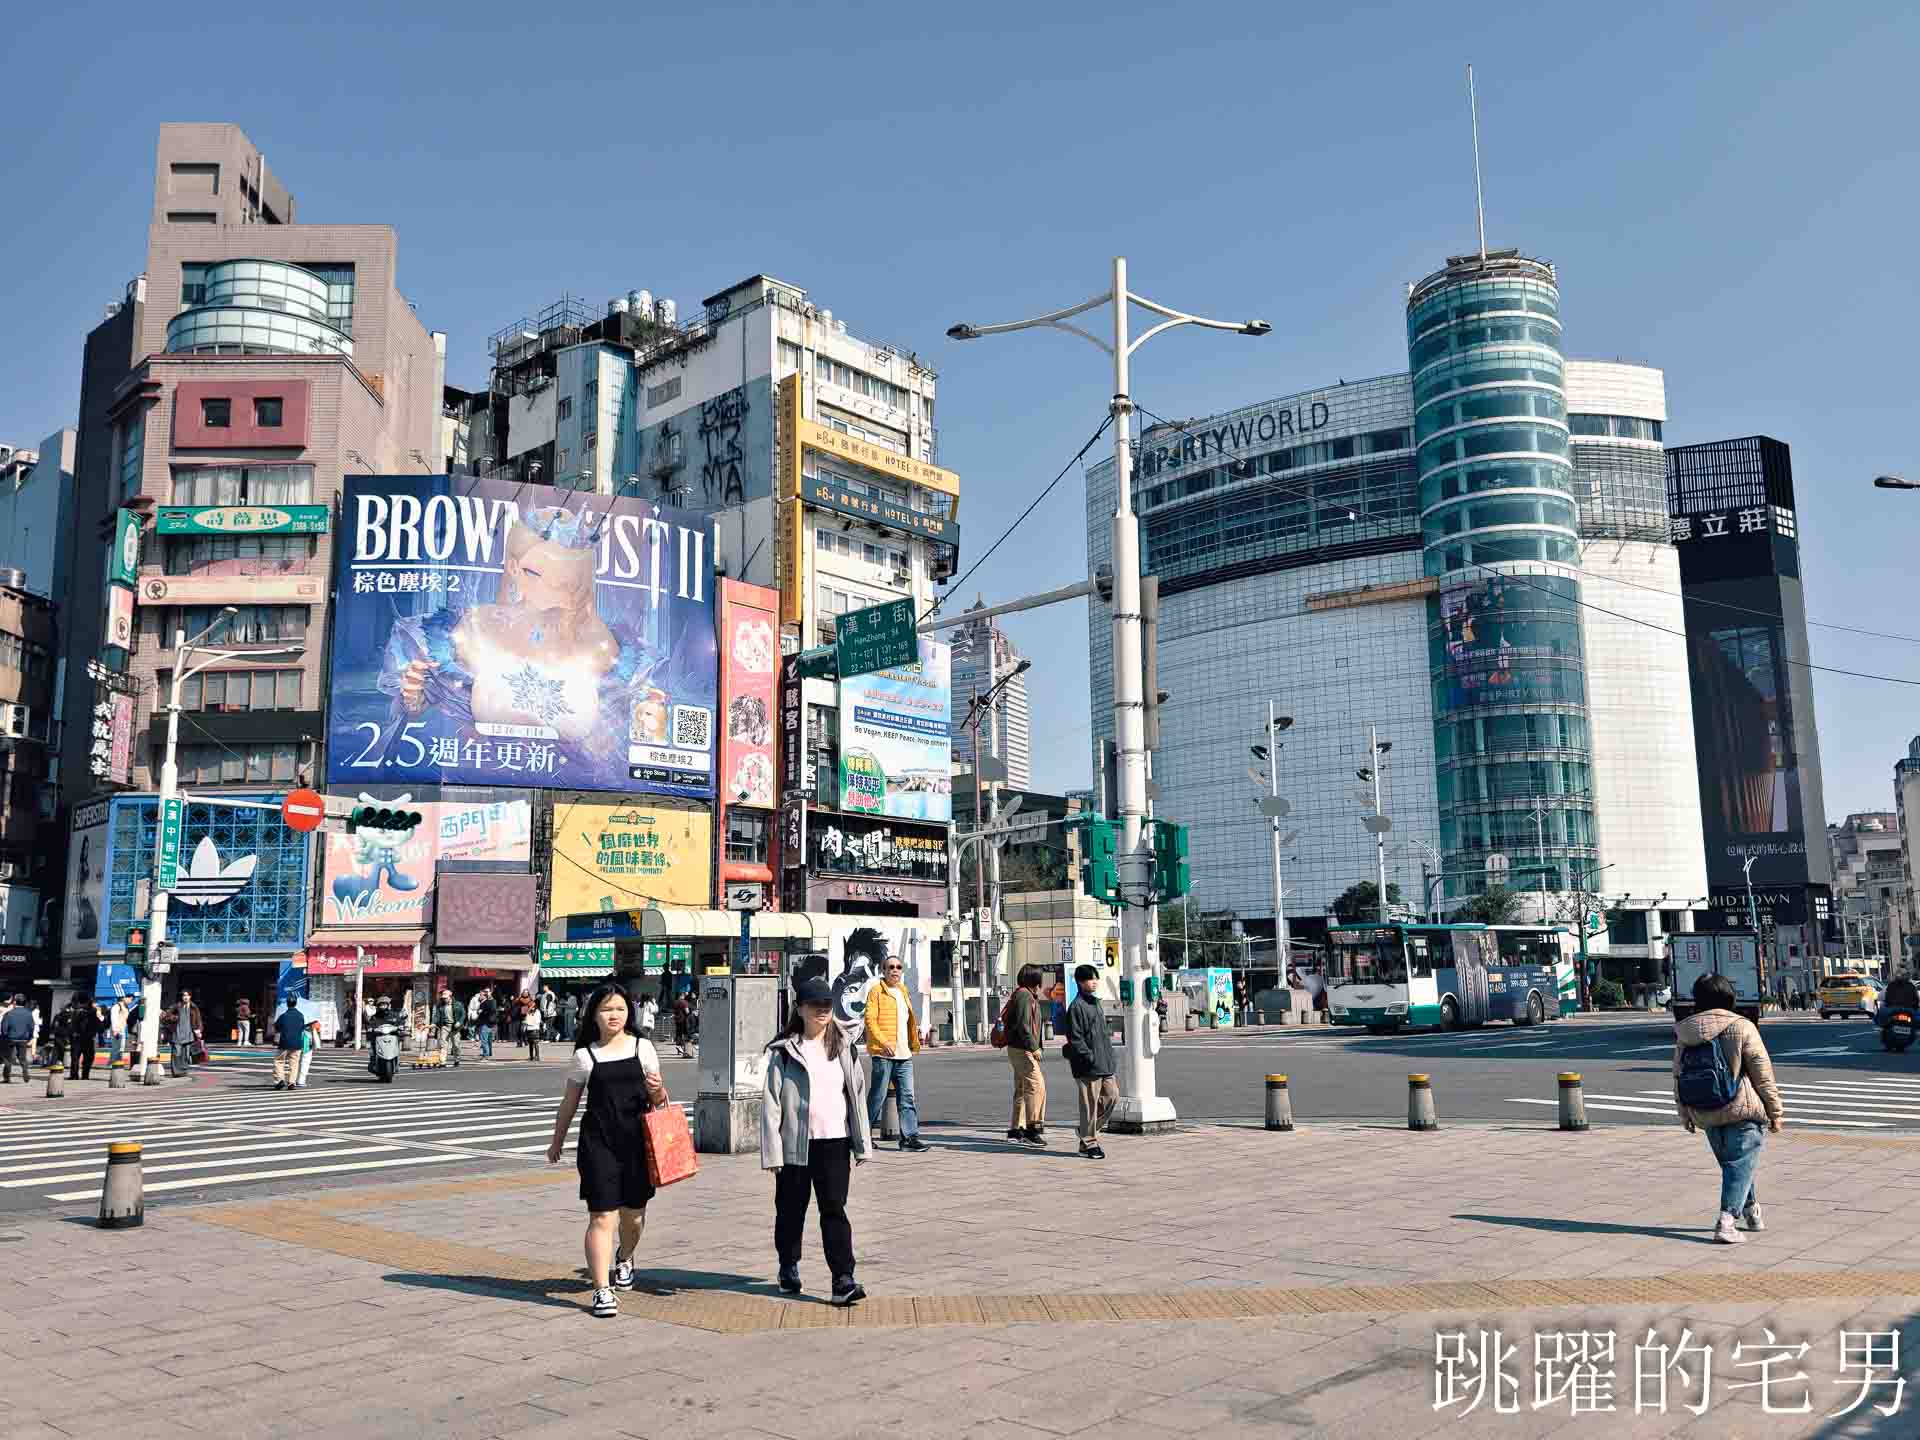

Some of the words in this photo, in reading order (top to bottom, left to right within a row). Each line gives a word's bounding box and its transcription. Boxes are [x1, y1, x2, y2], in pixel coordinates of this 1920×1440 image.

[885, 455, 912, 473] HOTEL
[884, 506, 911, 525] HOTEL
[845, 602, 906, 635] 漢中街
[847, 773, 881, 792] 保持和平
[166, 810, 177, 853] 漢中街
[820, 825, 884, 864] 肉之間
[330, 889, 431, 922] Welcome
[1105, 946, 1115, 968] 6
